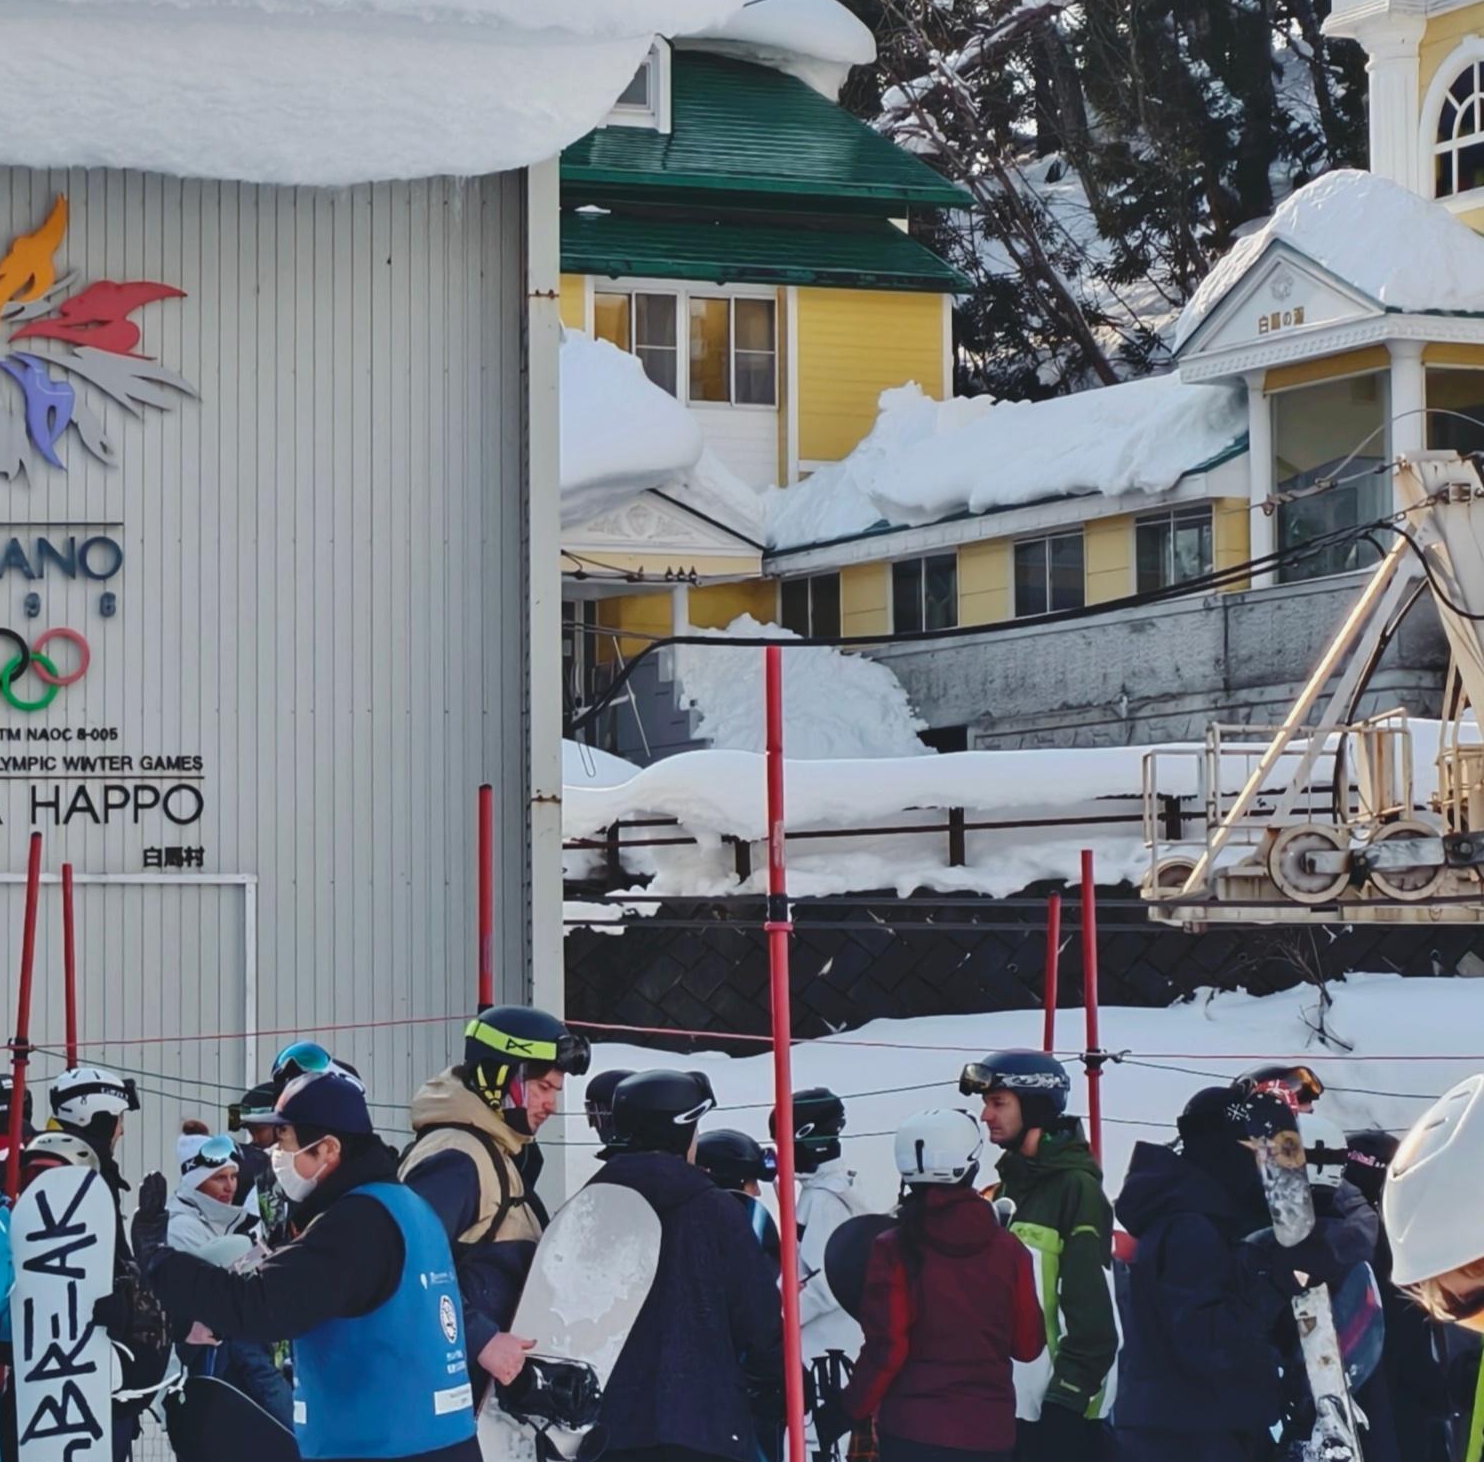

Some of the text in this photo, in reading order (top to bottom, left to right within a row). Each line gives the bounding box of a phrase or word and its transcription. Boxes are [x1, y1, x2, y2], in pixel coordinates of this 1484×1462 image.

[26, 727, 73, 743] NAOC
[62, 755, 134, 773] WINTER
[139, 754, 205, 772] GAMES
[29, 783, 206, 826] HAPPO
